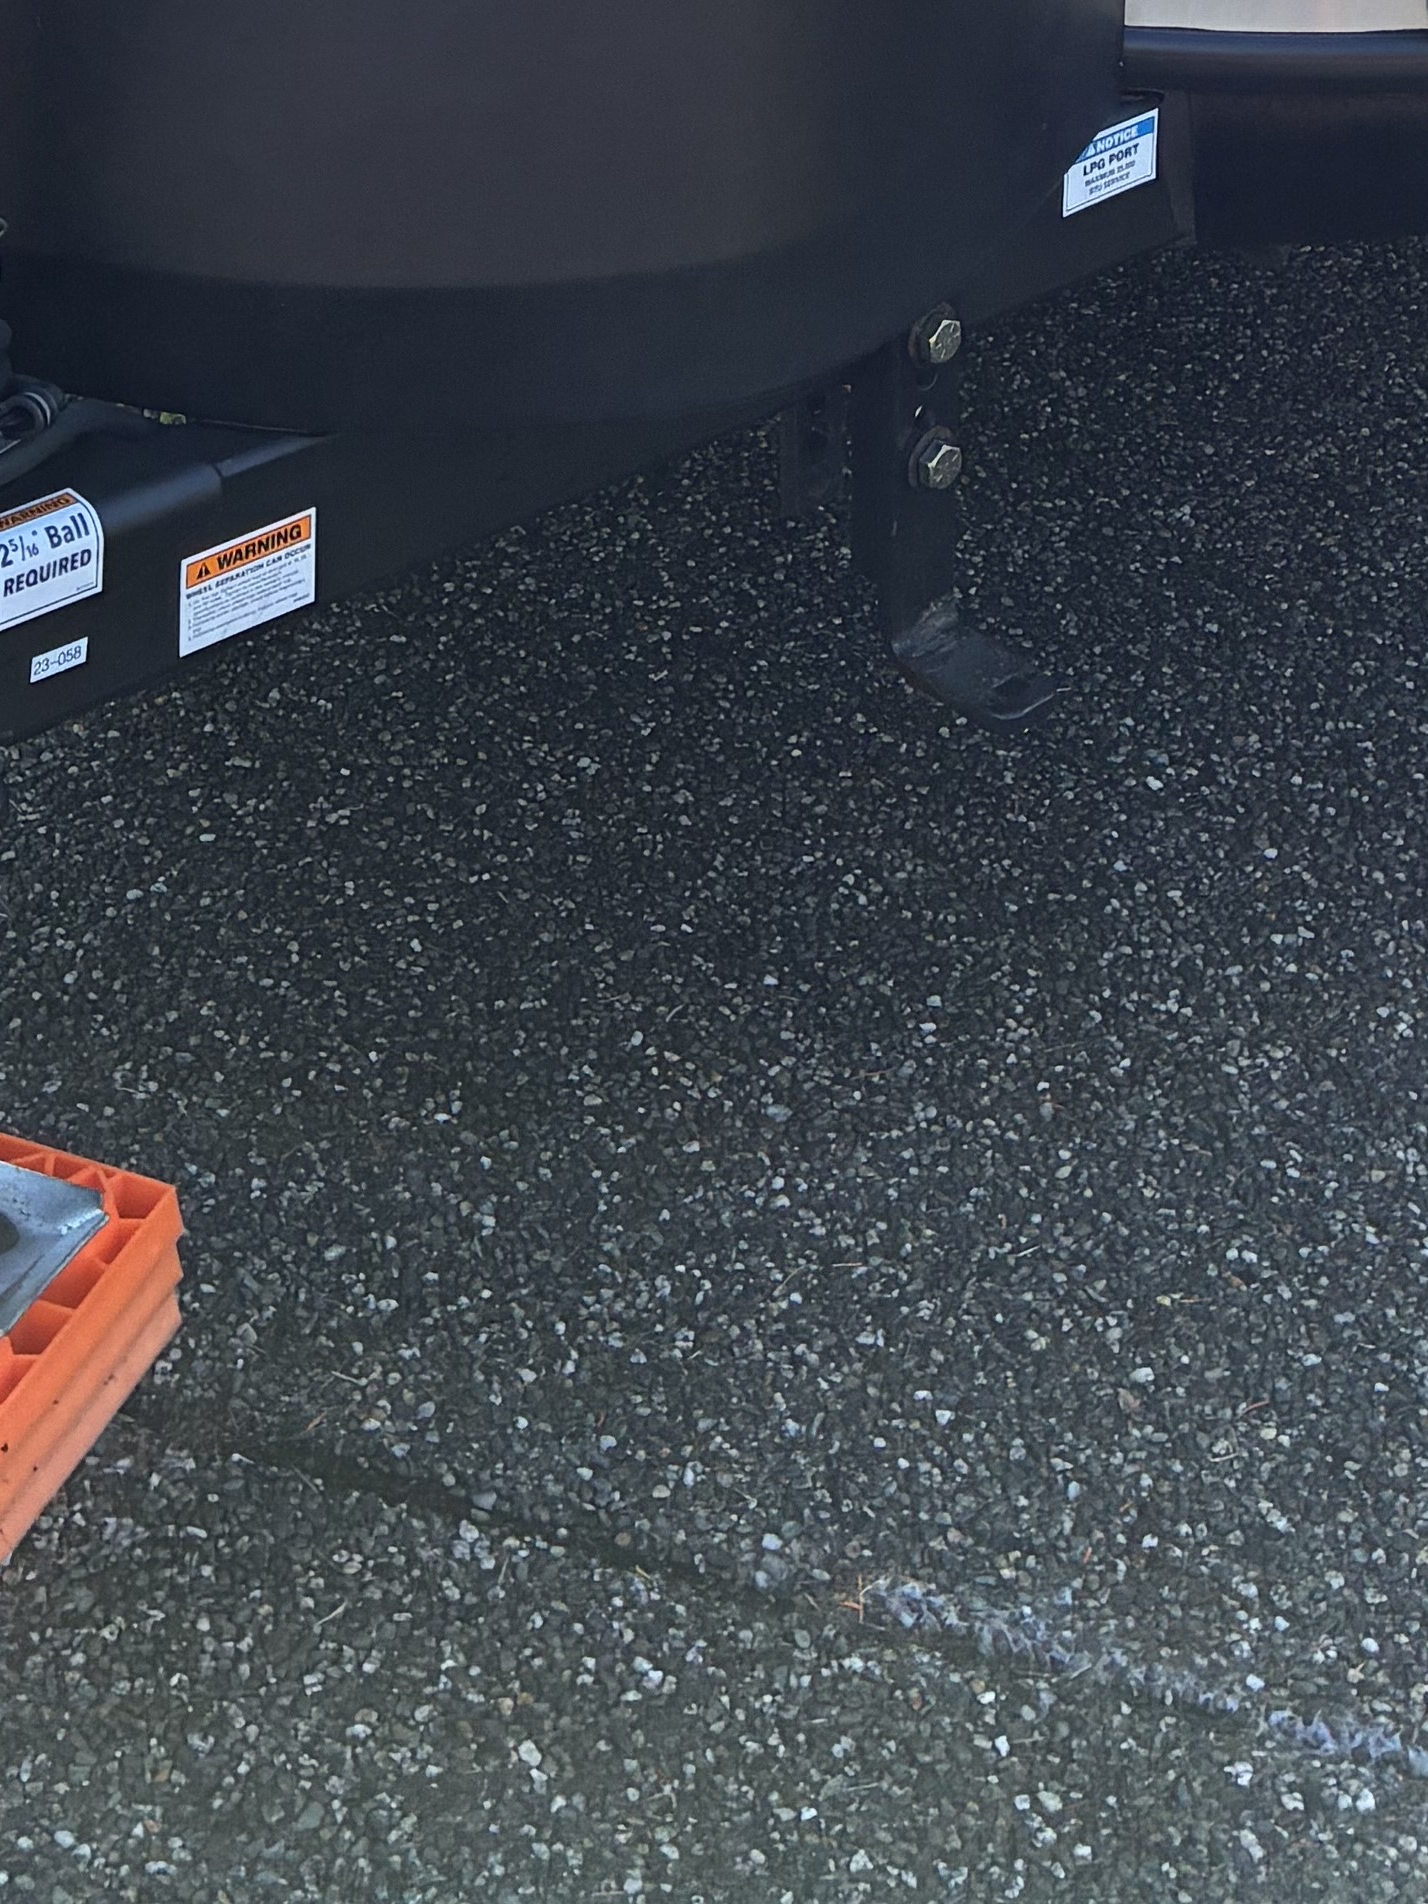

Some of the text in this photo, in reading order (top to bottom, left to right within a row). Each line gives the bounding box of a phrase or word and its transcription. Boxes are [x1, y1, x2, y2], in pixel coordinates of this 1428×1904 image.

[1096, 124, 1139, 153] NOTICE
[1083, 143, 1140, 177] LPG PORT
[44, 512, 91, 549] Ball
[216, 523, 302, 571] WARNING
[3, 548, 92, 597] REQUIRED
[33, 645, 82, 676] 23-058
